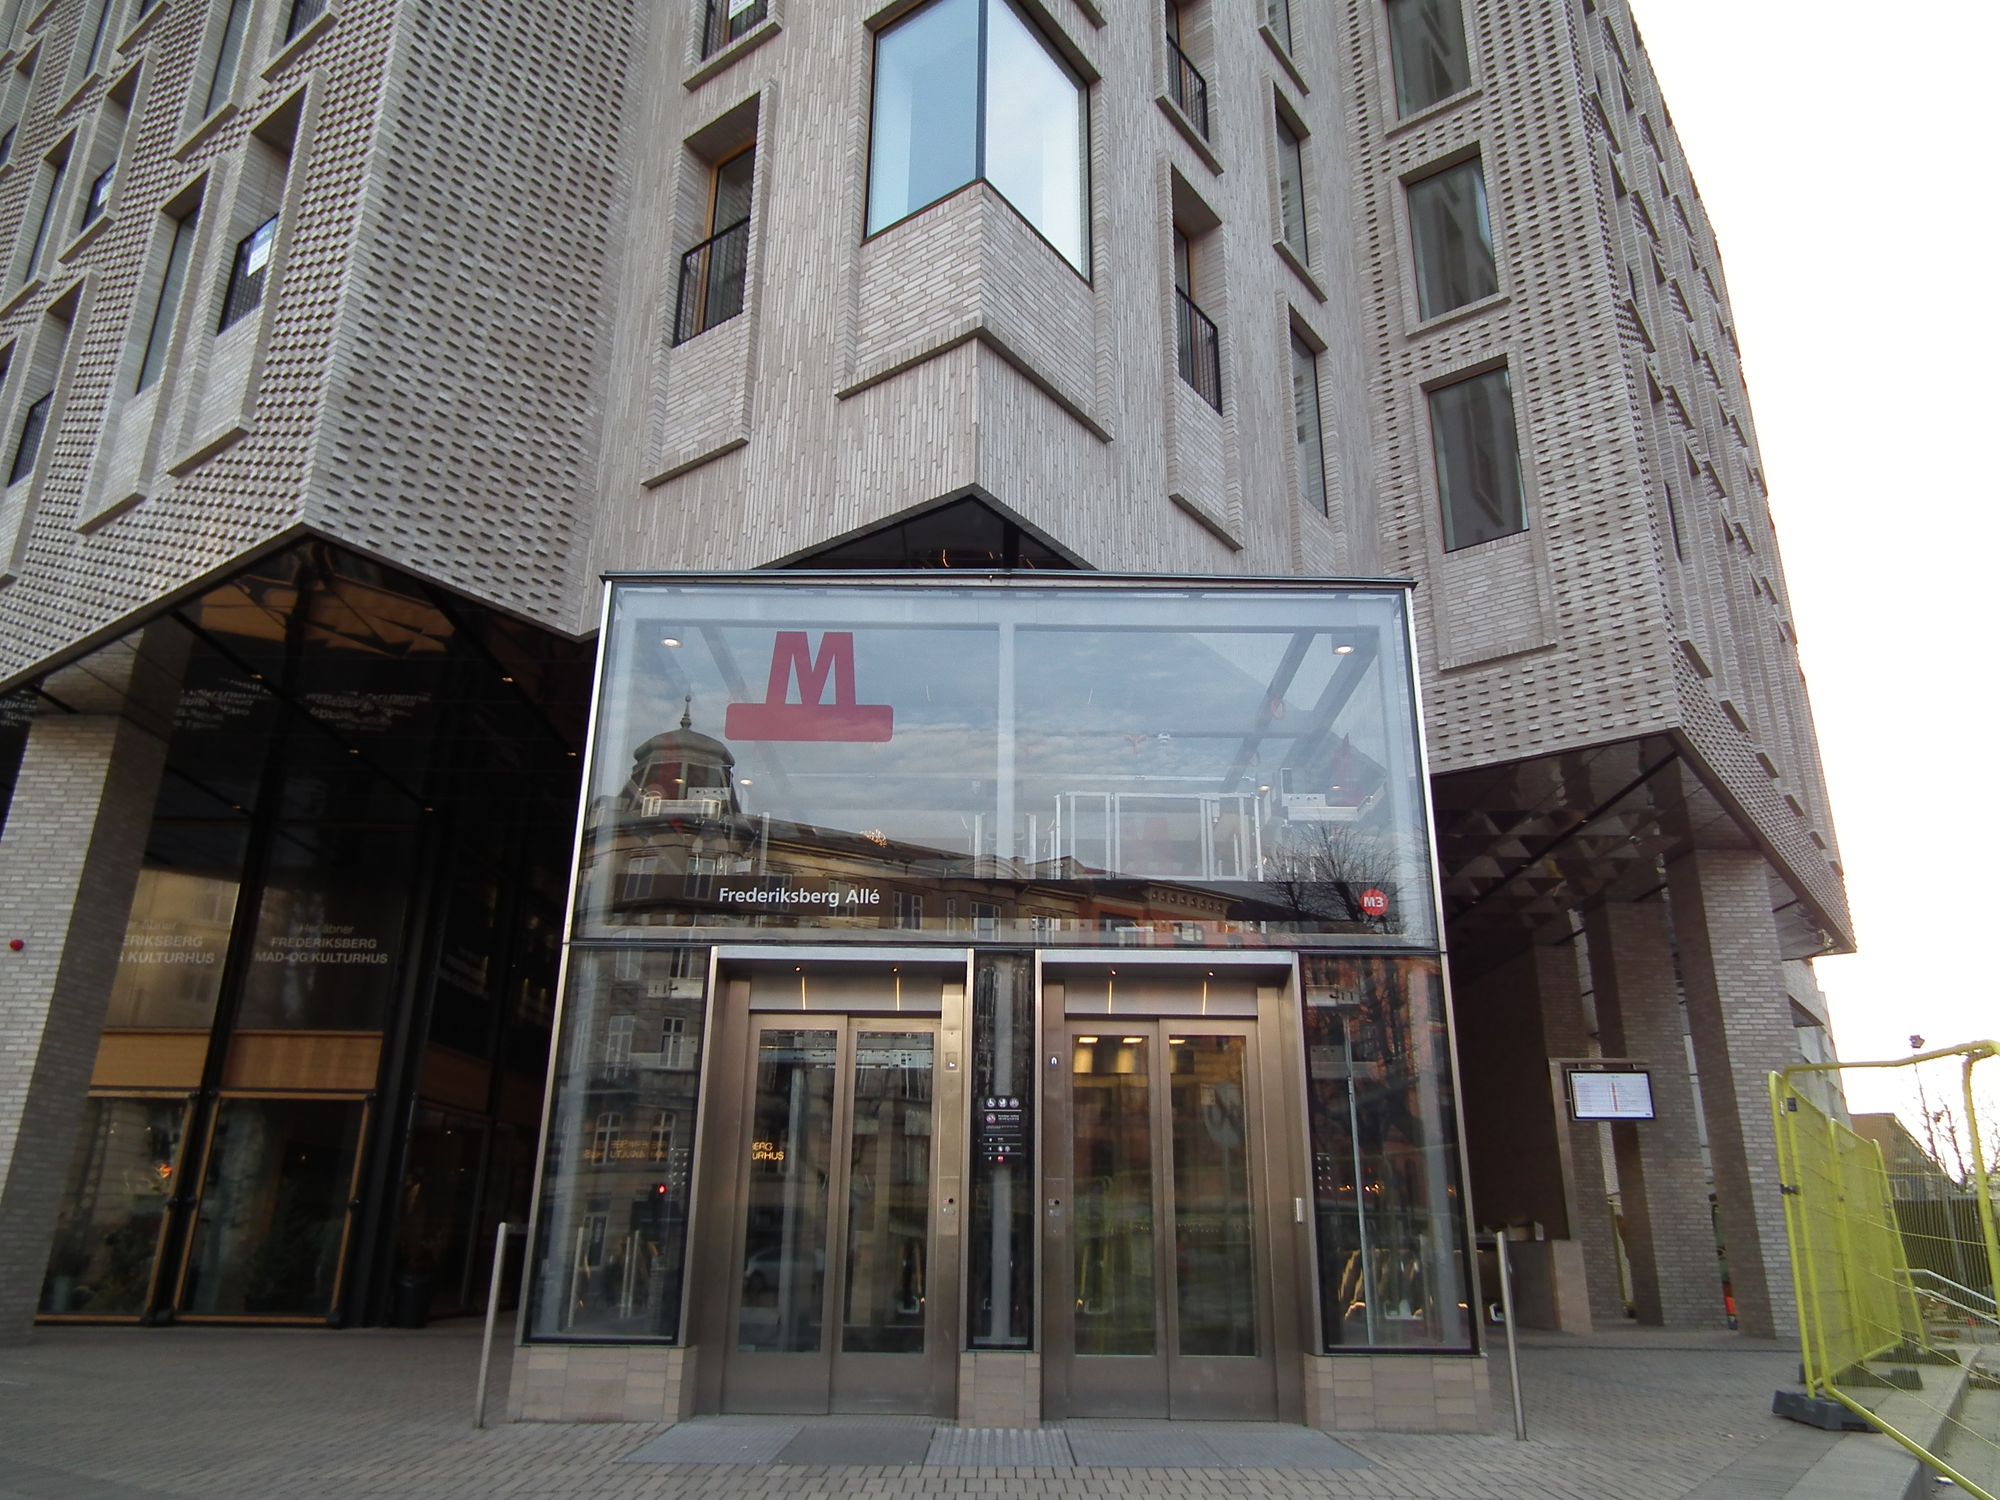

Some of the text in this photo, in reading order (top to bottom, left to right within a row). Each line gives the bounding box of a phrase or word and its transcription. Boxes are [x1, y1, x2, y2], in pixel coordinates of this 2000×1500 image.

[765, 631, 857, 705] M
[719, 887, 880, 907] Frederiksberg Allé
[1363, 896, 1384, 907] M3
[271, 937, 377, 949] FREDERIKSBERG
[127, 951, 215, 964] KULTURHUS
[311, 953, 388, 964] KULTURHUS
